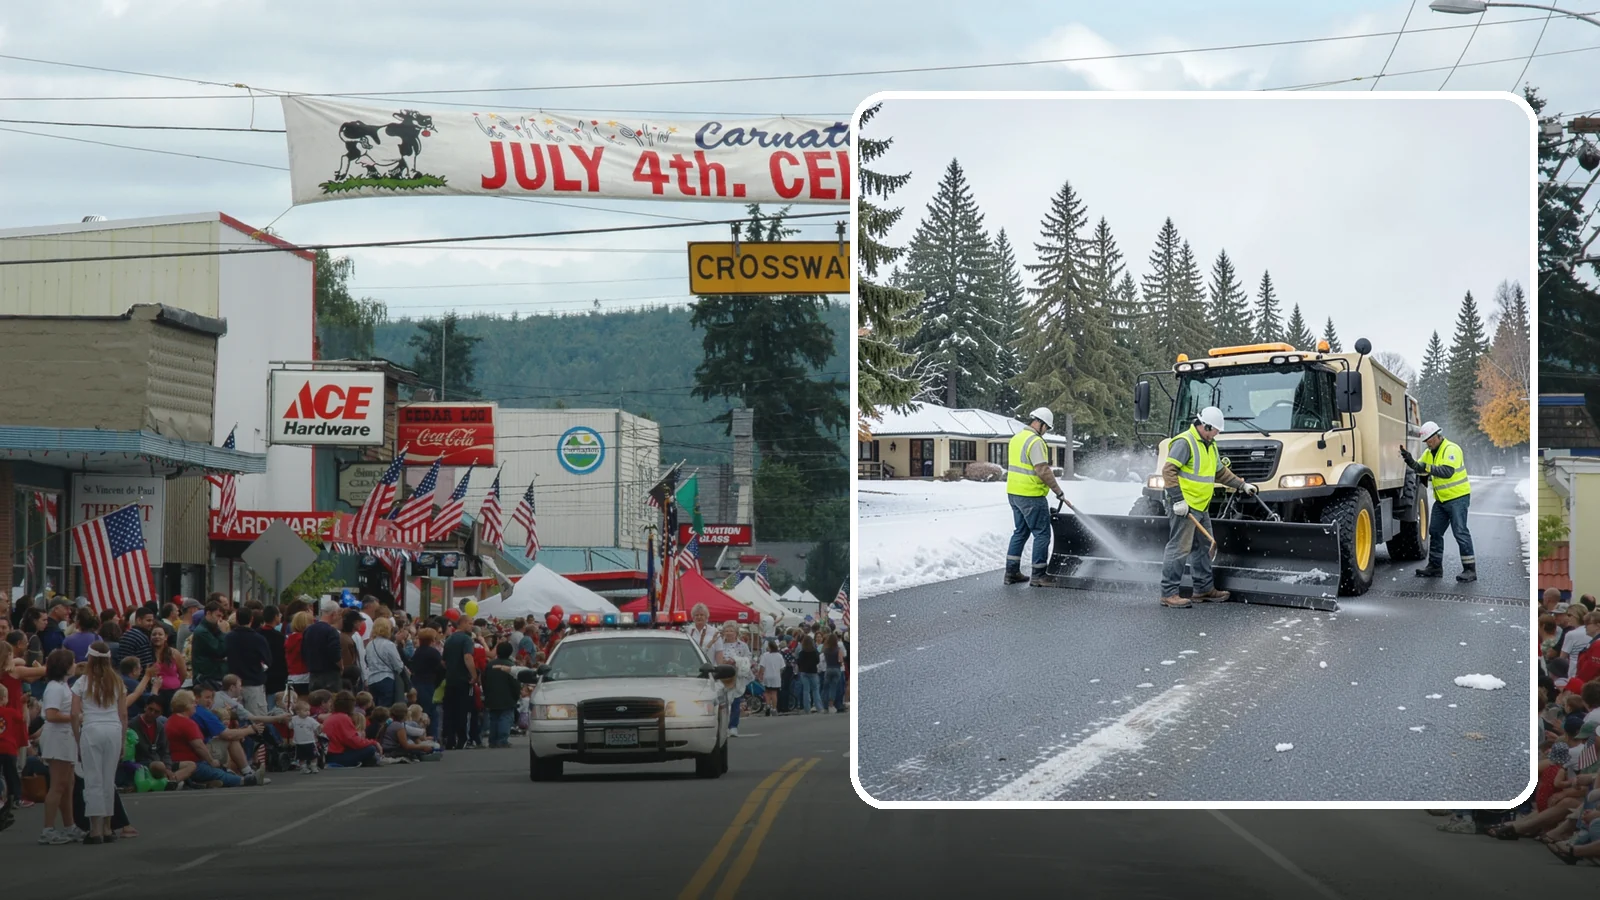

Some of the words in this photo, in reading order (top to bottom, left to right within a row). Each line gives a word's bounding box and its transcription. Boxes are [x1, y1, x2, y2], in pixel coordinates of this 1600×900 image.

[695, 121, 850, 150] Carnat
[481, 141, 604, 192] JULY
[632, 150, 746, 197] 4th.
[697, 254, 850, 280] CROSSWA
[282, 380, 373, 420] ACE
[405, 409, 453, 422] CEDAR
[283, 421, 371, 437] Hardware
[416, 428, 477, 447] Coca-Cola
[353, 467, 385, 480] Simpl
[96, 485, 124, 495] Vincent
[126, 486, 135, 495] de
[137, 486, 155, 496] Paul
[81, 503, 153, 522] THT
[212, 515, 331, 536] HARDARE
[688, 526, 741, 535] CRNATION
[699, 535, 730, 544] GLASS
